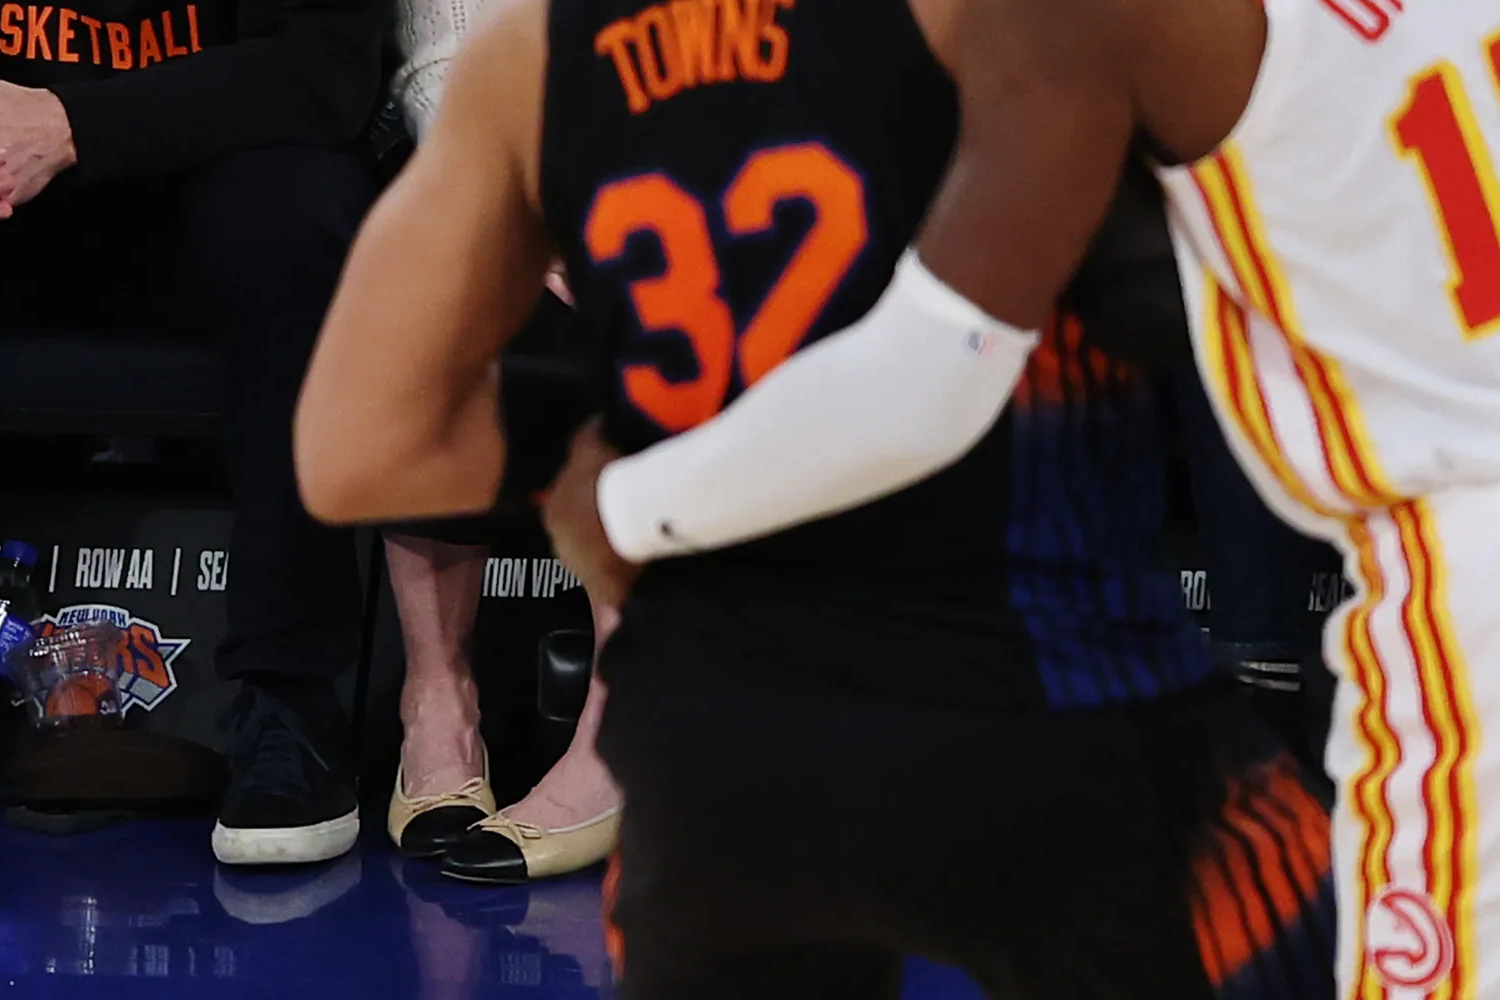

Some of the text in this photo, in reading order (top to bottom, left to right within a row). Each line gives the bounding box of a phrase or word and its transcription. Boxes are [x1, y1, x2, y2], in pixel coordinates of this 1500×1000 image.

[1385, 25, 1500, 342] 1
[583, 140, 869, 434] 32
[74, 547, 126, 589] ROW
[125, 548, 154, 590] AA
[197, 550, 230, 592] SE
[1180, 570, 1211, 611] RO
